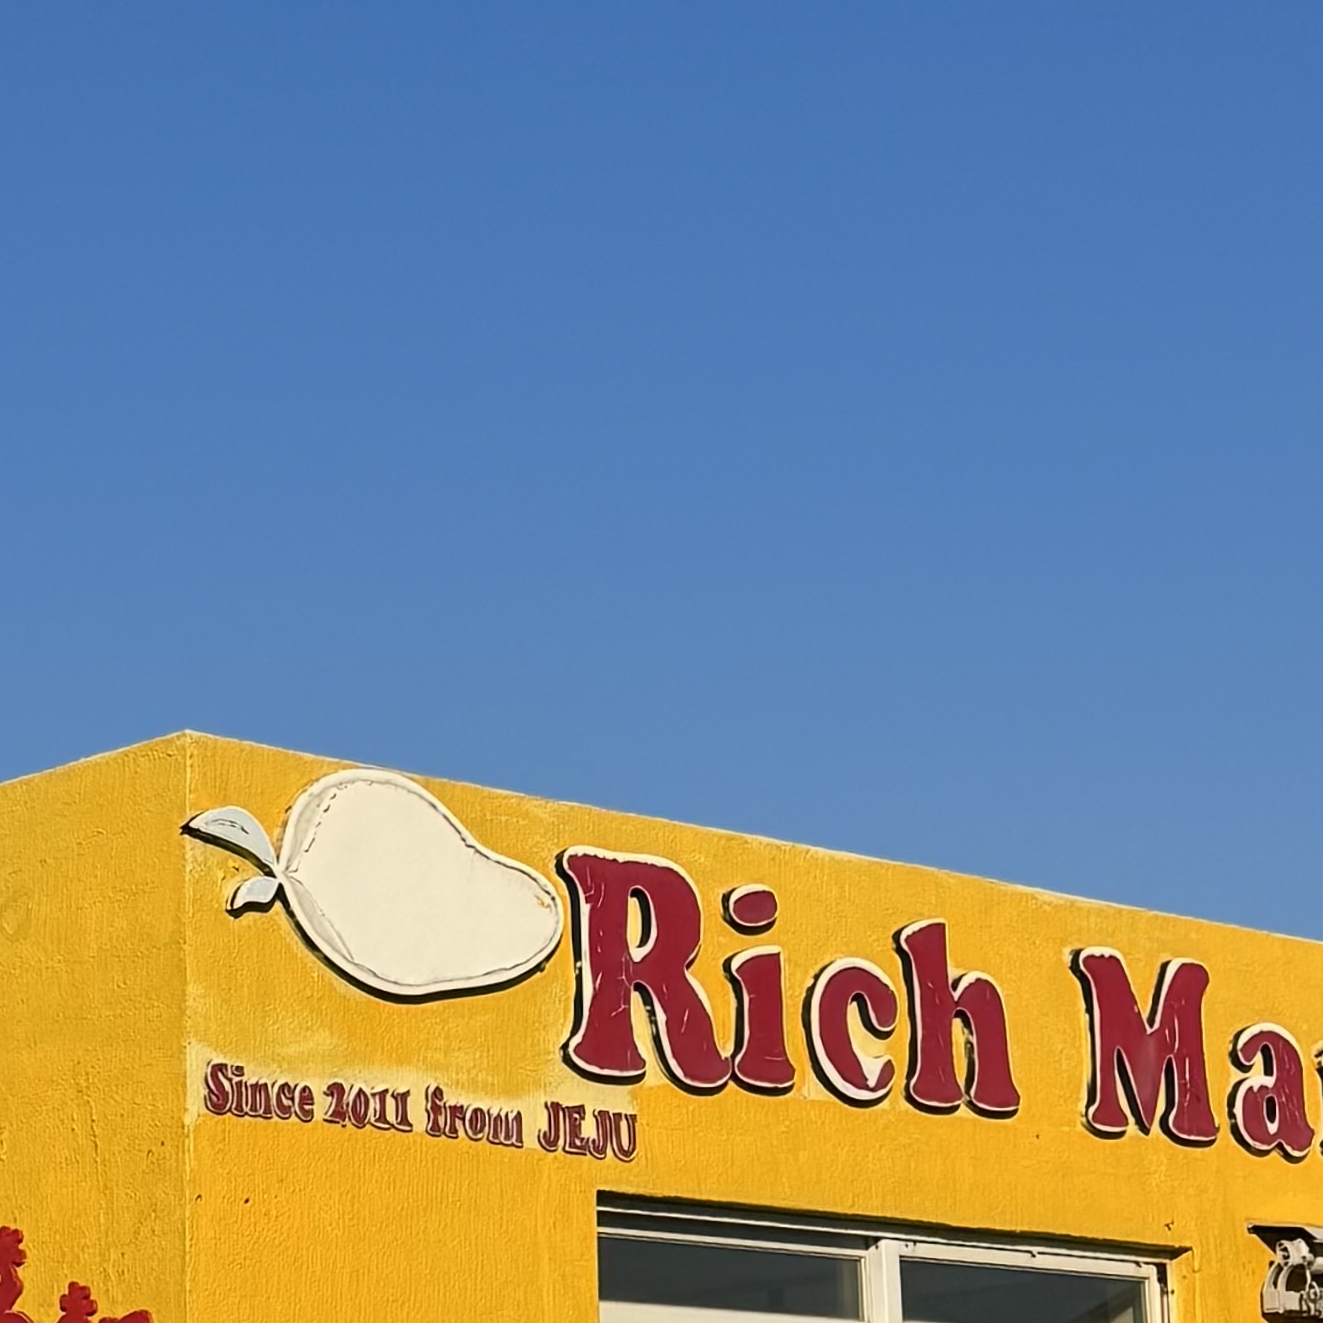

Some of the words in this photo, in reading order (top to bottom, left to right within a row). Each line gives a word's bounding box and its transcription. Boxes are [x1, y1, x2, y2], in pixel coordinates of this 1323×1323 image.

[557, 845, 1020, 1119] Rich
[205, 1060, 315, 1122] Since
[323, 1080, 413, 1133] 2011
[426, 1084, 524, 1148] from
[538, 1101, 637, 1162] JEJU
